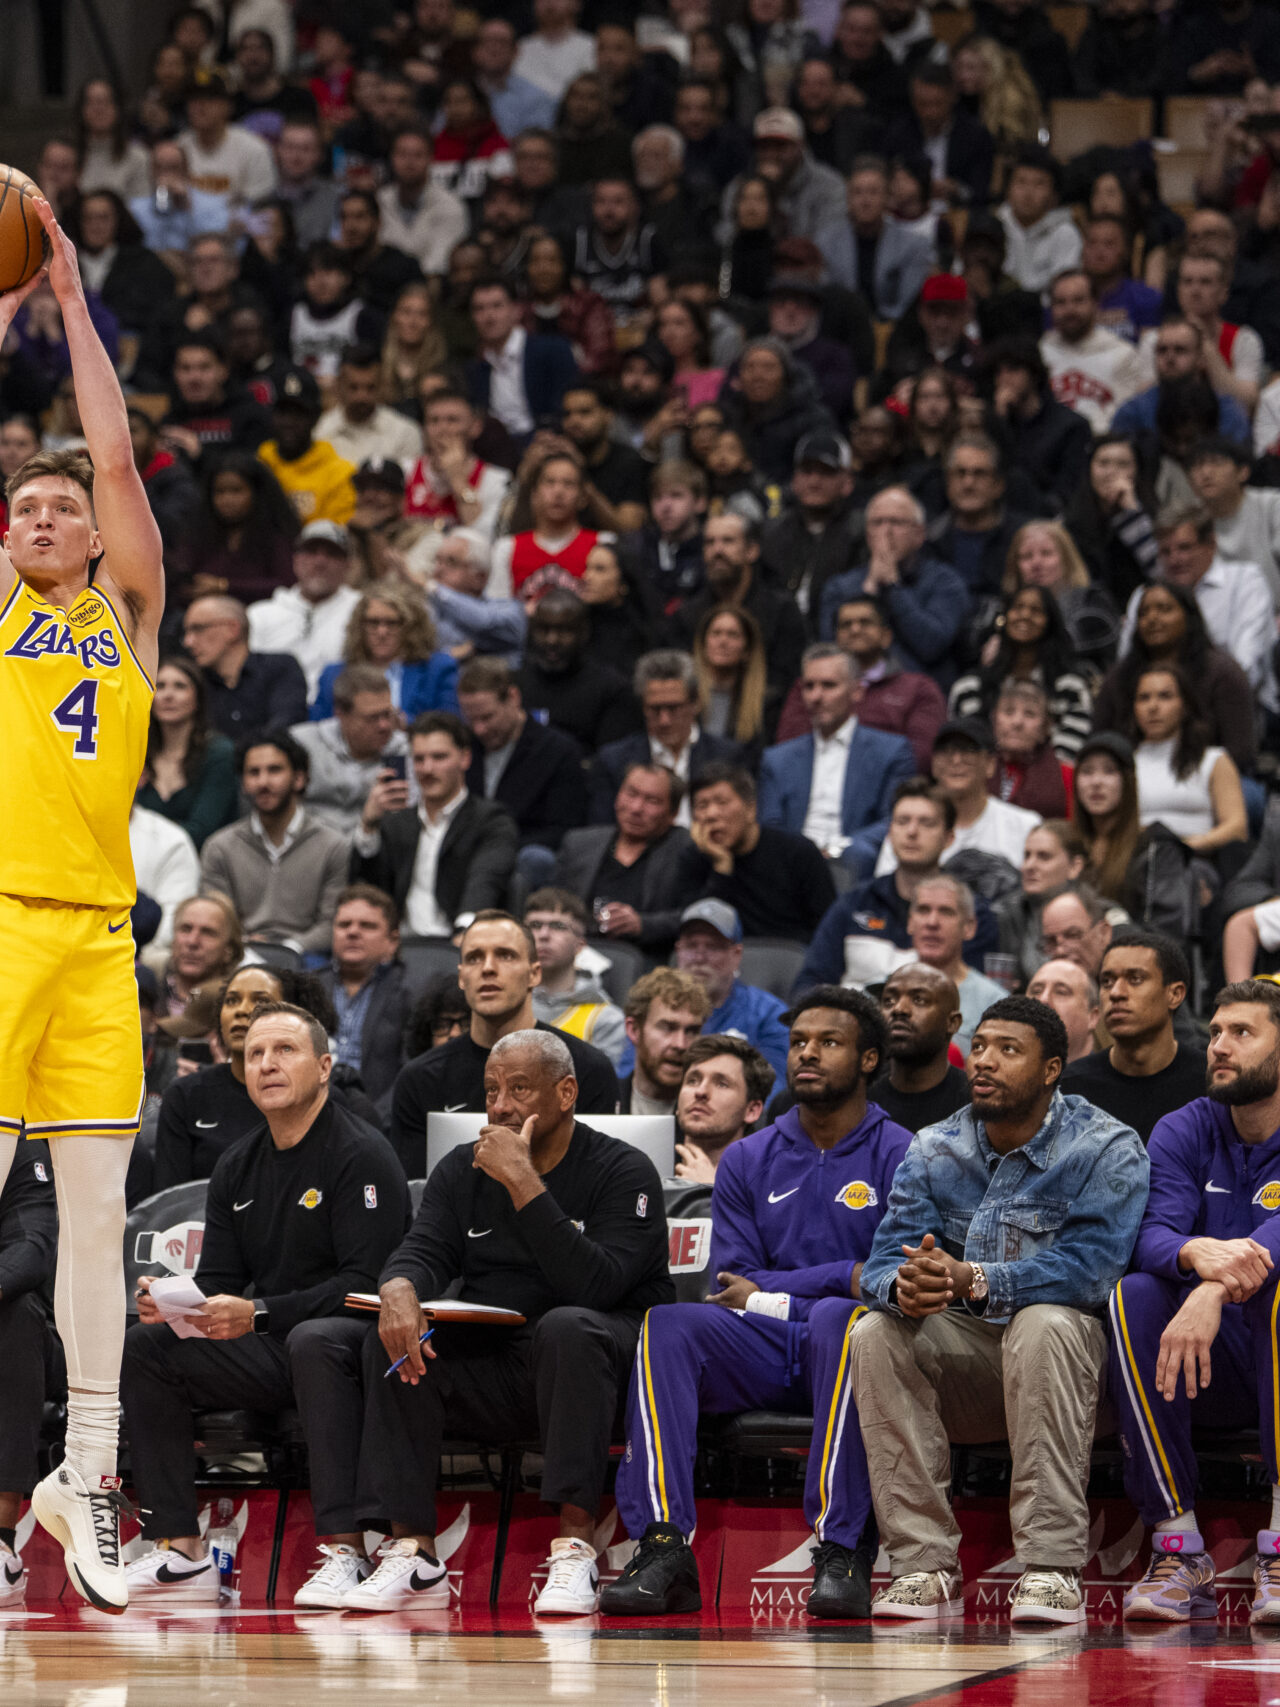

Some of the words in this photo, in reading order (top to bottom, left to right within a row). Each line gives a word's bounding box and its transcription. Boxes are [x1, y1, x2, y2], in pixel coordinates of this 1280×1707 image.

[4, 610, 121, 670] LAKRS
[70, 602, 102, 624] bibigo
[49, 678, 99, 760] 4
